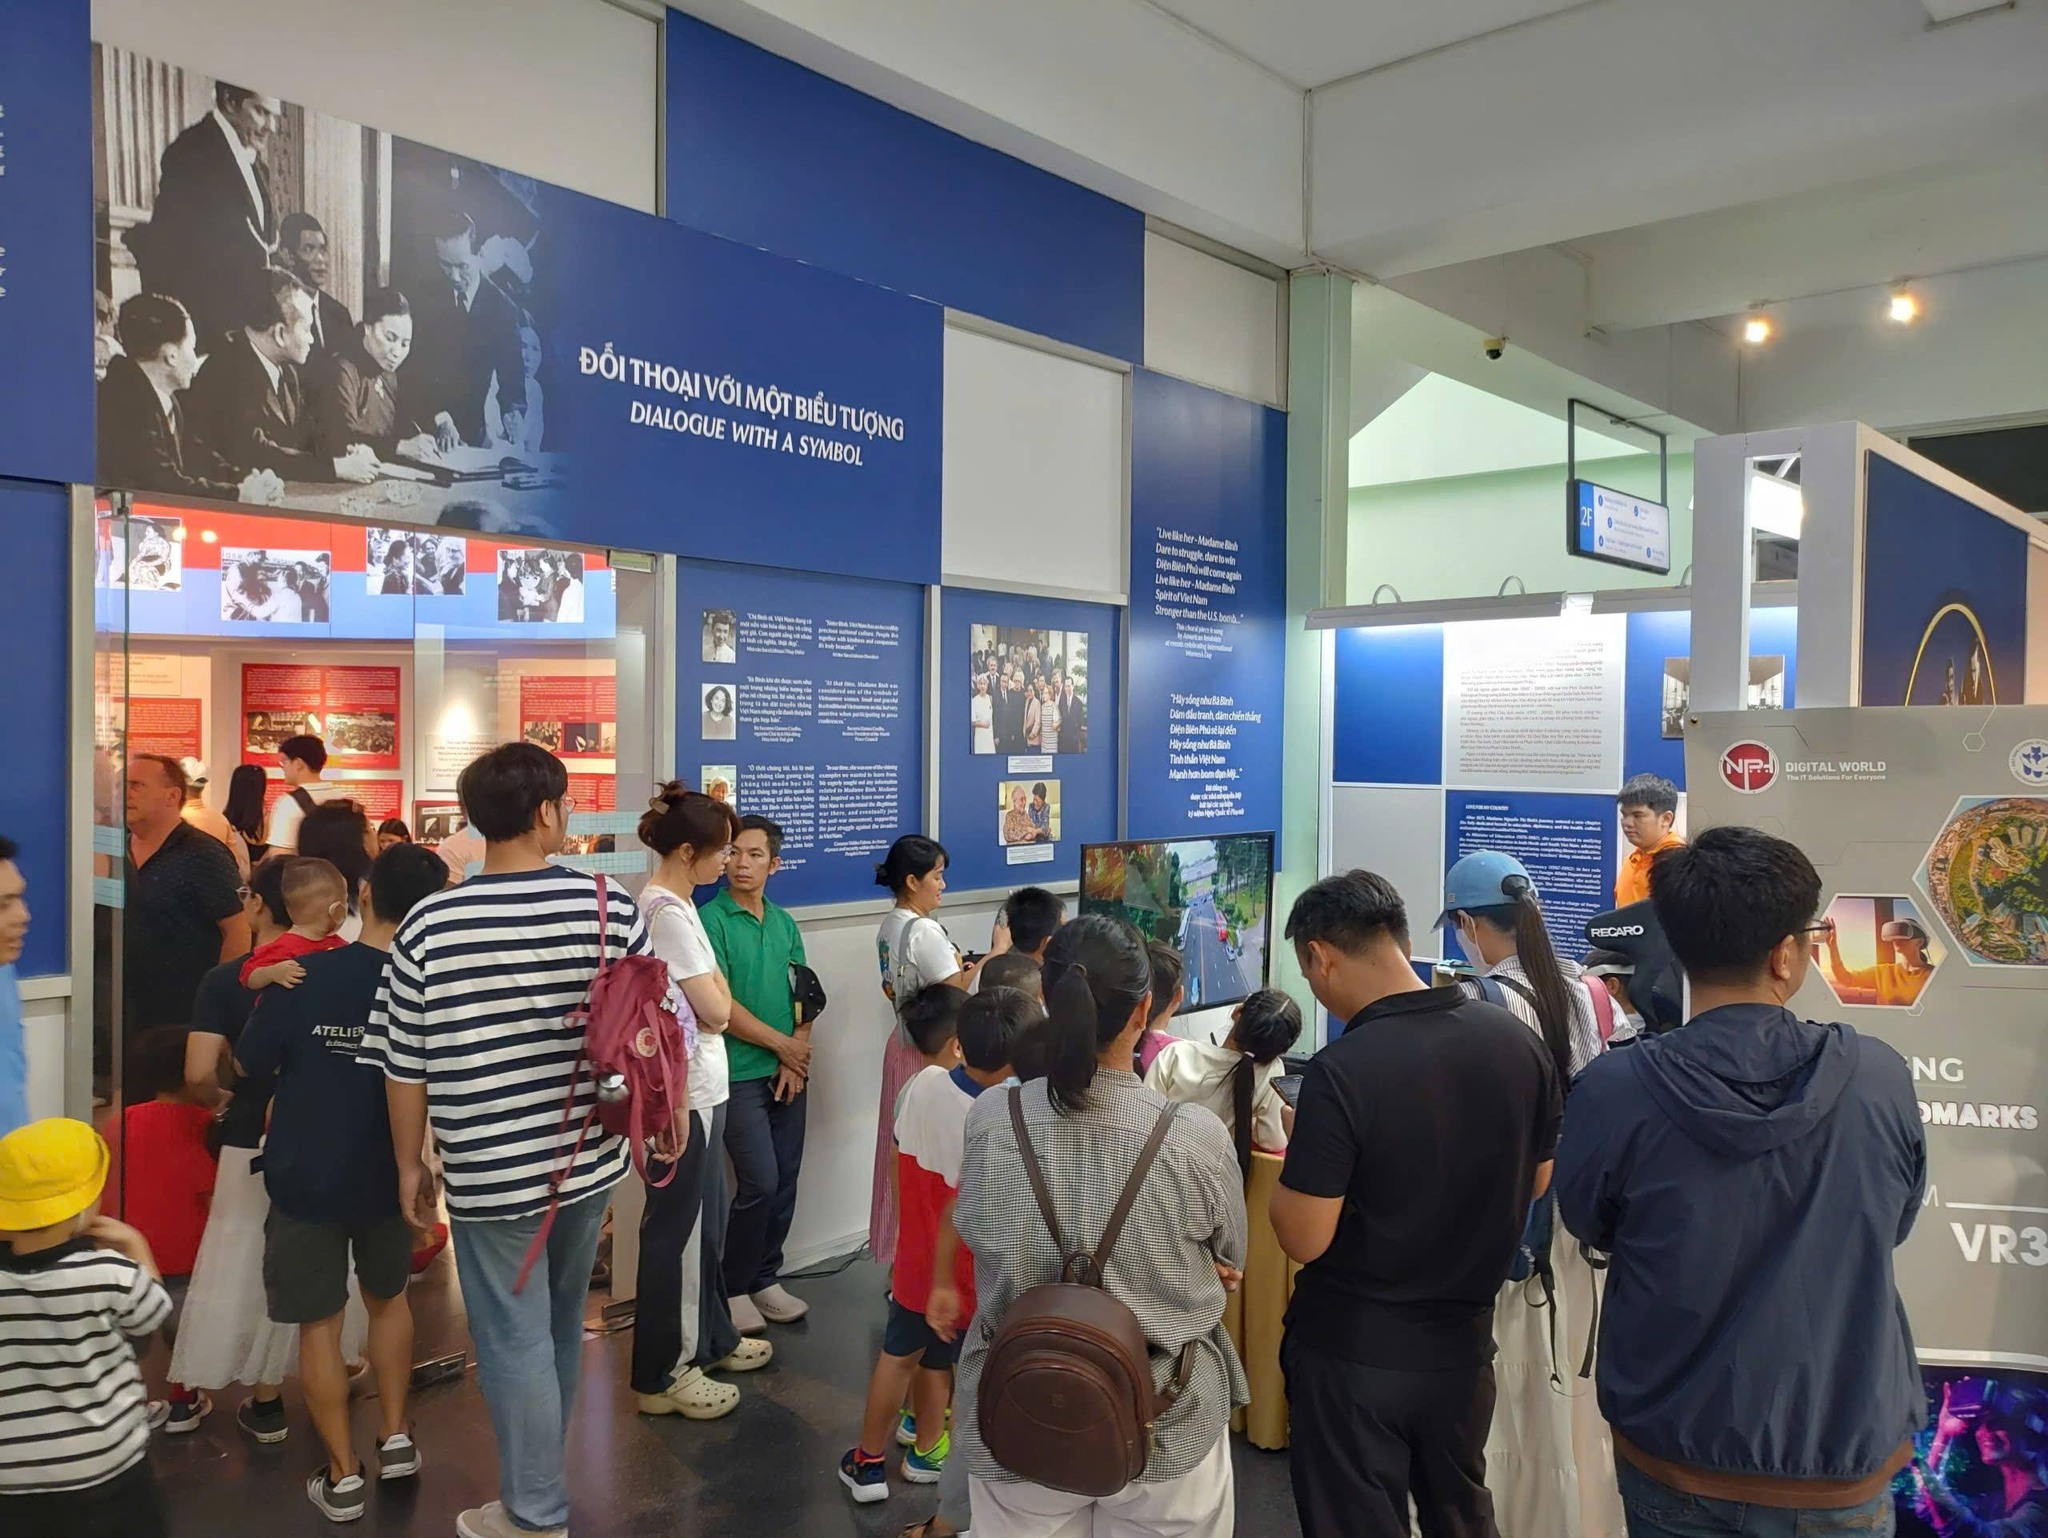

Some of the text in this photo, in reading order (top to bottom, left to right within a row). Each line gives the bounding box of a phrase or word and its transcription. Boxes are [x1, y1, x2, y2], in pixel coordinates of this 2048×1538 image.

[629, 358, 700, 401] THOẠI
[704, 374, 741, 407] VỚI
[745, 385, 793, 420] MỘT
[795, 392, 836, 426] BIỂU
[840, 405, 904, 441] TƯỢNG
[630, 401, 863, 466] DIALOGUE WITH A SYMBOL
[1581, 506, 1592, 526] 2F
[1172, 530, 1183, 542] like
[1184, 532, 1194, 543] her
[1198, 535, 1224, 549] Madame
[1156, 543, 1172, 555] Dare
[1172, 546, 1178, 556] to
[1205, 552, 1219, 563] dare
[1219, 555, 1224, 564] to
[1225, 556, 1235, 566] win
[1155, 574, 1169, 585] Live
[1169, 575, 1180, 587] like
[1180, 577, 1191, 588] her
[1195, 580, 1221, 593] Madame
[1199, 566, 1209, 576] will
[1210, 569, 1226, 579] come
[1226, 571, 1242, 582] again
[1155, 589, 1172, 602] Spirit
[1173, 591, 1180, 601] of
[1193, 594, 1208, 605] Nam
[1155, 604, 1182, 619] Stronger
[1183, 608, 1197, 619] than
[1197, 610, 1208, 620] the
[1786, 762, 1886, 772] DIGITAL WORLD
[1591, 925, 1643, 937] RECARO
[312, 1025, 365, 1037] ATELIER
[1904, 1056, 1963, 1081] NG
[1949, 1223, 2048, 1266] VR3
